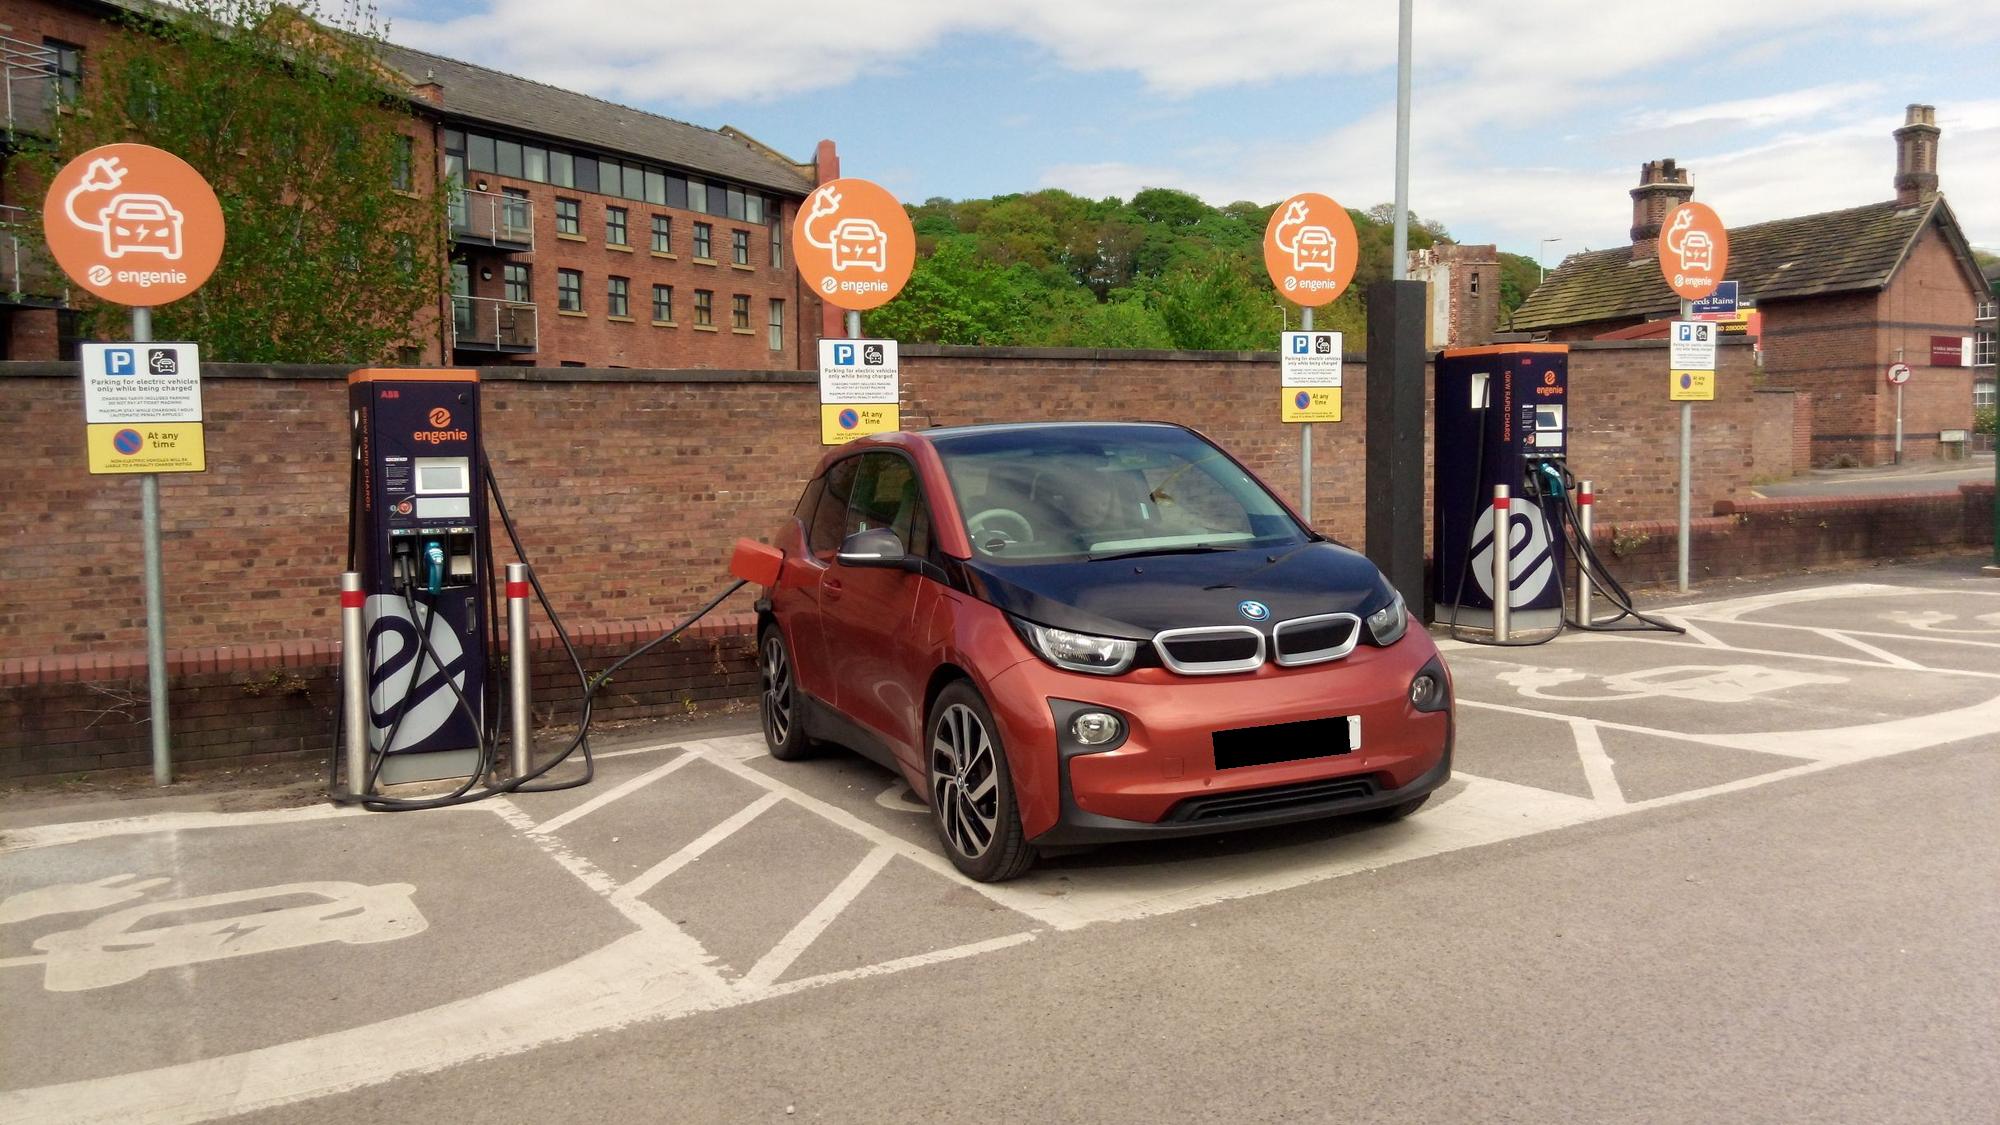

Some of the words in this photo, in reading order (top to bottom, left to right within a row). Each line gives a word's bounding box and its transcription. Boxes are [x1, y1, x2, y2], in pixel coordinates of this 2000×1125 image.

[118, 269, 187, 287] engenie
[1685, 278, 1712, 287] engenie
[841, 279, 888, 294] engenie
[1299, 279, 1335, 291] engenie
[1682, 327, 1689, 339] P
[1297, 338, 1306, 352] P
[839, 346, 851, 364] P
[111, 352, 130, 373] P
[380, 390, 399, 398] ABB
[1537, 386, 1562, 396] engenie
[162, 433, 179, 441] any
[414, 429, 467, 444] engenie
